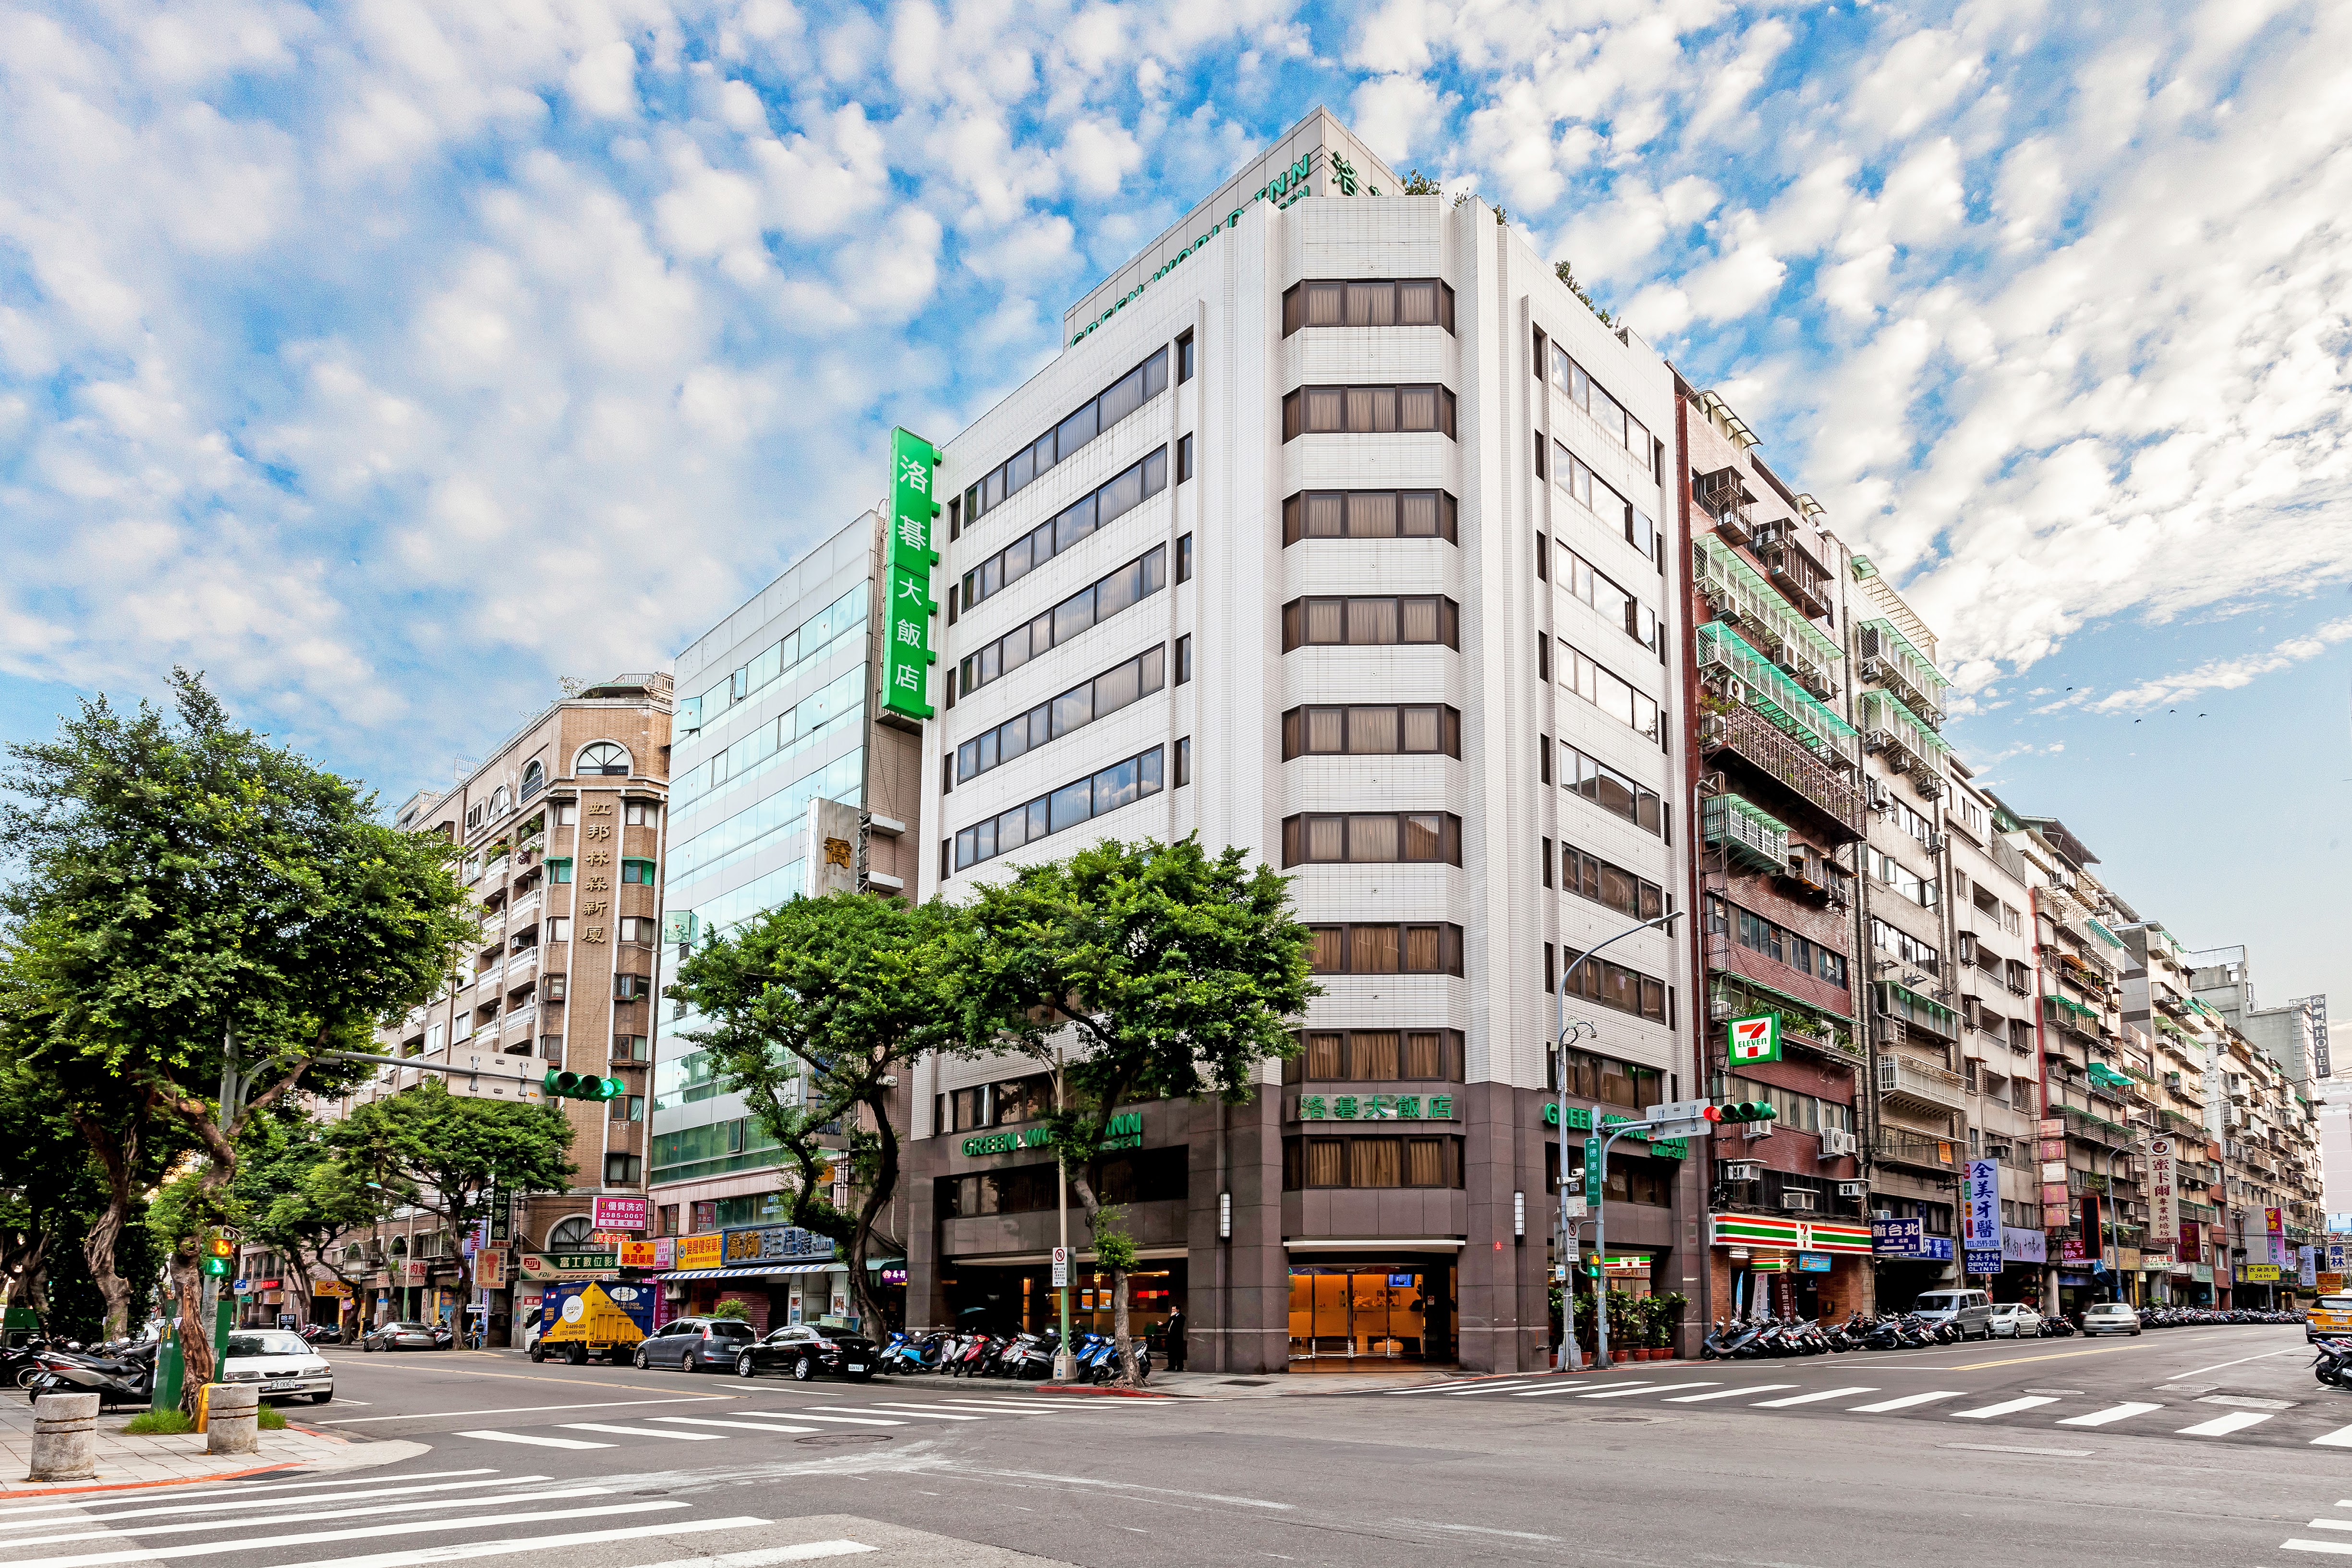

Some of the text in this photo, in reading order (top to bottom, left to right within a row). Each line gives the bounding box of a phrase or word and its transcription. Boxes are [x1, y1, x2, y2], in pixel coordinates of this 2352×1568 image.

[895, 454, 929, 692] 洛碁大飯店
[2315, 1029, 2328, 1075] HOTEL
[1301, 1095, 1452, 1118] 洛碁大飯店
[962, 1132, 1017, 1156] GREEN
[1588, 1148, 1598, 1185] 德惠街
[608, 1202, 644, 1212] 優質洗衣
[1972, 1162, 1995, 1238] 全美牙醫
[1873, 1223, 1918, 1237] 新台北
[560, 1256, 618, 1267] 富士數位影
